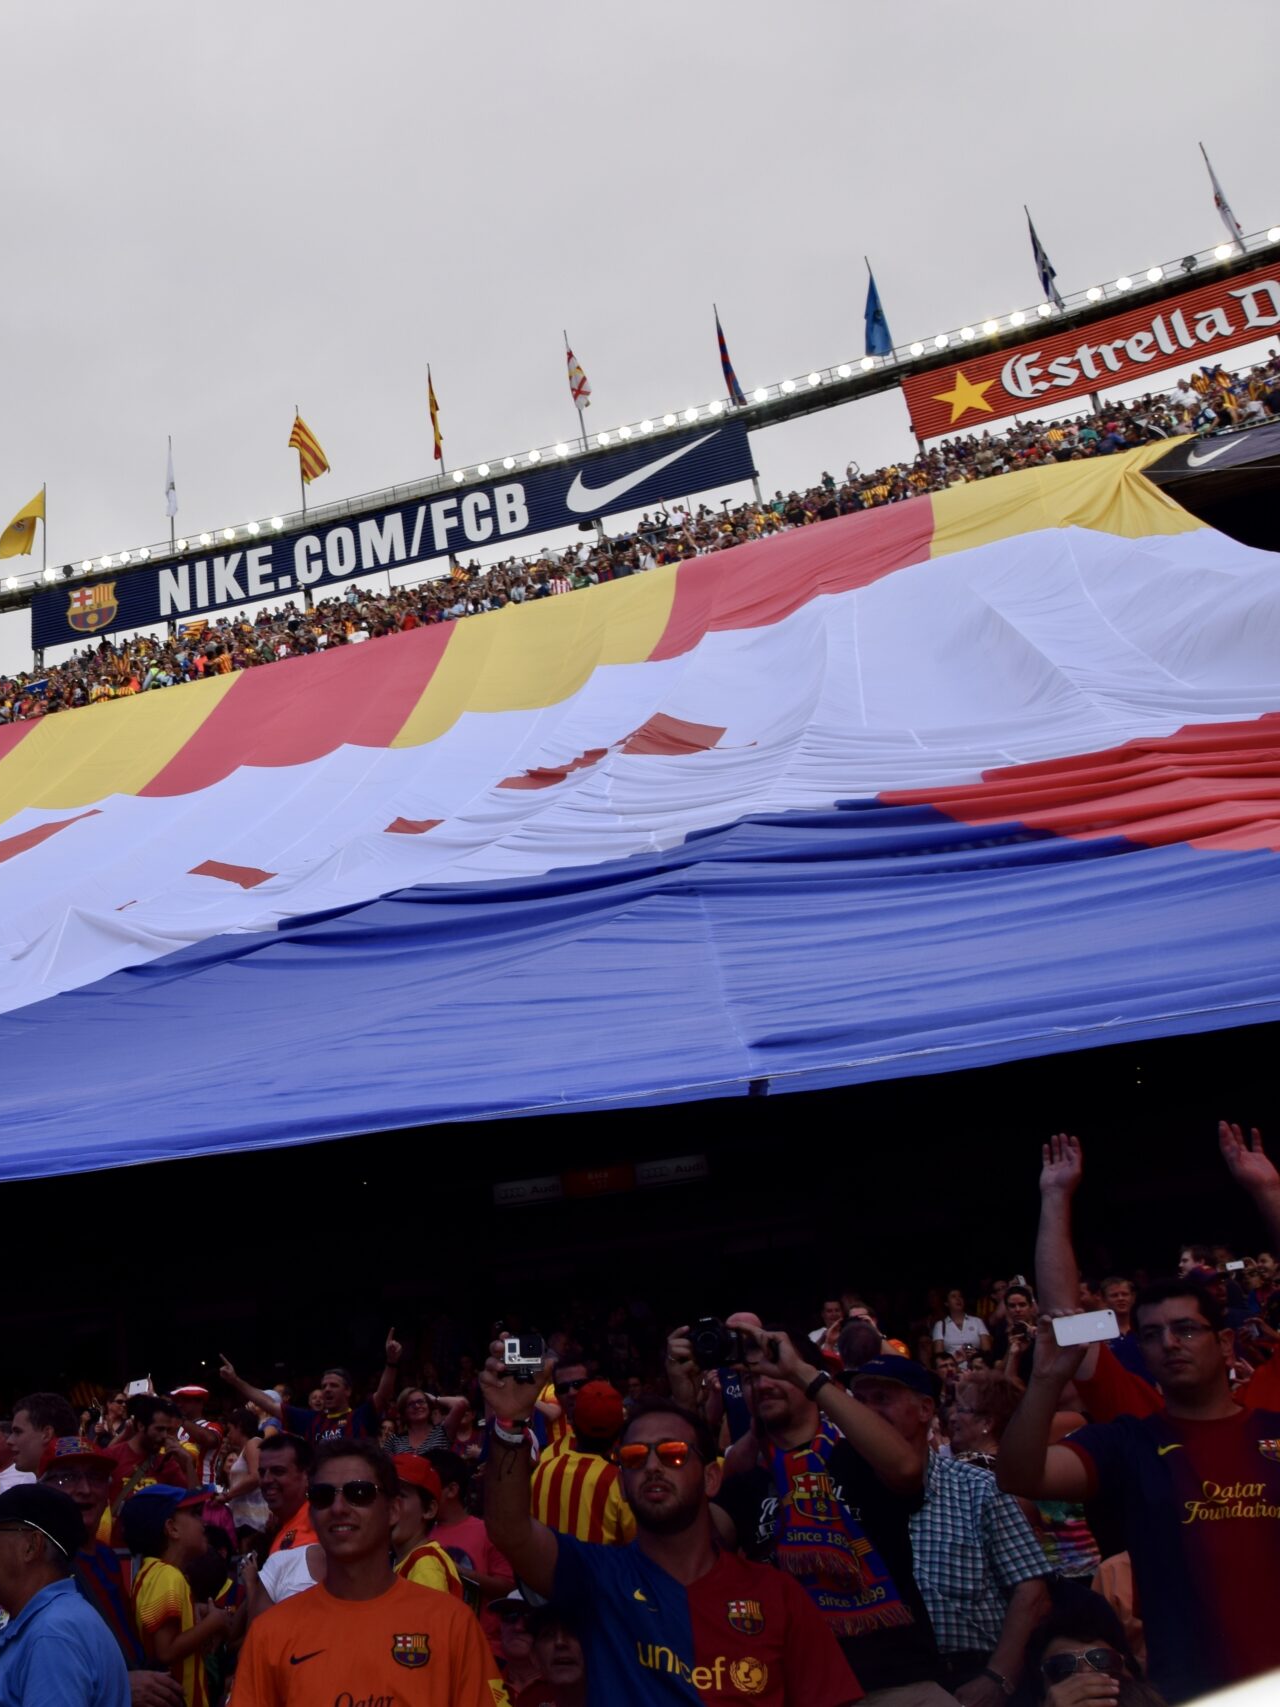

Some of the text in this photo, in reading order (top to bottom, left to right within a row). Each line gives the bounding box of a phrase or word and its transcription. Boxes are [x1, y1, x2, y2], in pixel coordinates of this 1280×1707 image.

[1000, 306, 1236, 399] Estrella
[157, 482, 530, 617] NIKE.COM/FCB
[530, 1183, 560, 1196] Audi
[1201, 1480, 1267, 1504] Qatar
[1181, 1498, 1280, 1525] Foundatio
[786, 1529, 850, 1548] since 189
[818, 1591, 851, 1608] since
[636, 1640, 727, 1691] unicef
